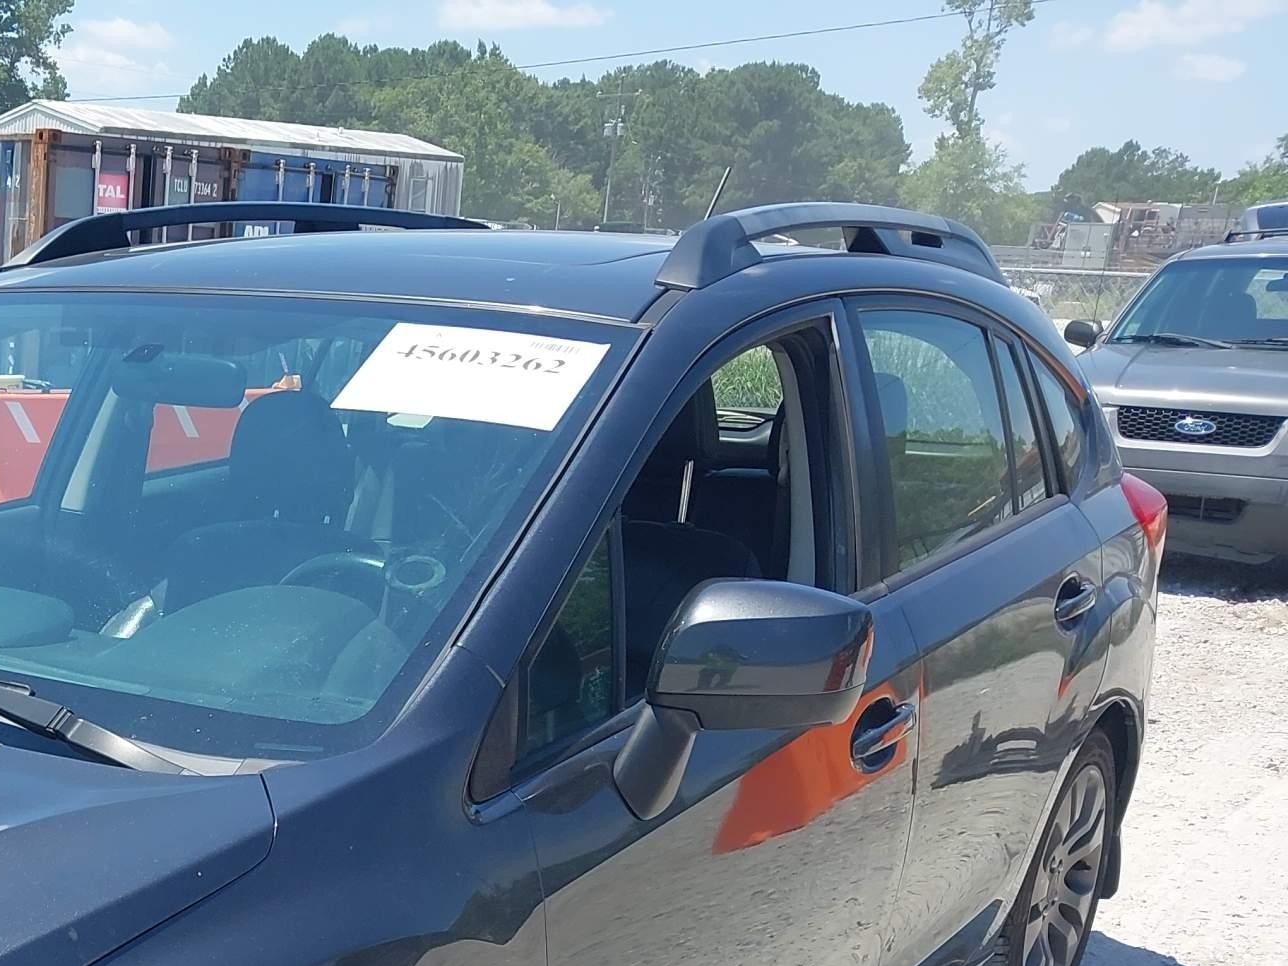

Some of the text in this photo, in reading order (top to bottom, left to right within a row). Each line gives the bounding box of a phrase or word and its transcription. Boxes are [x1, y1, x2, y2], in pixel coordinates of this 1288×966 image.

[97, 183, 126, 199] TAL
[173, 178, 189, 194] TCLU
[397, 344, 566, 374] 45603262
